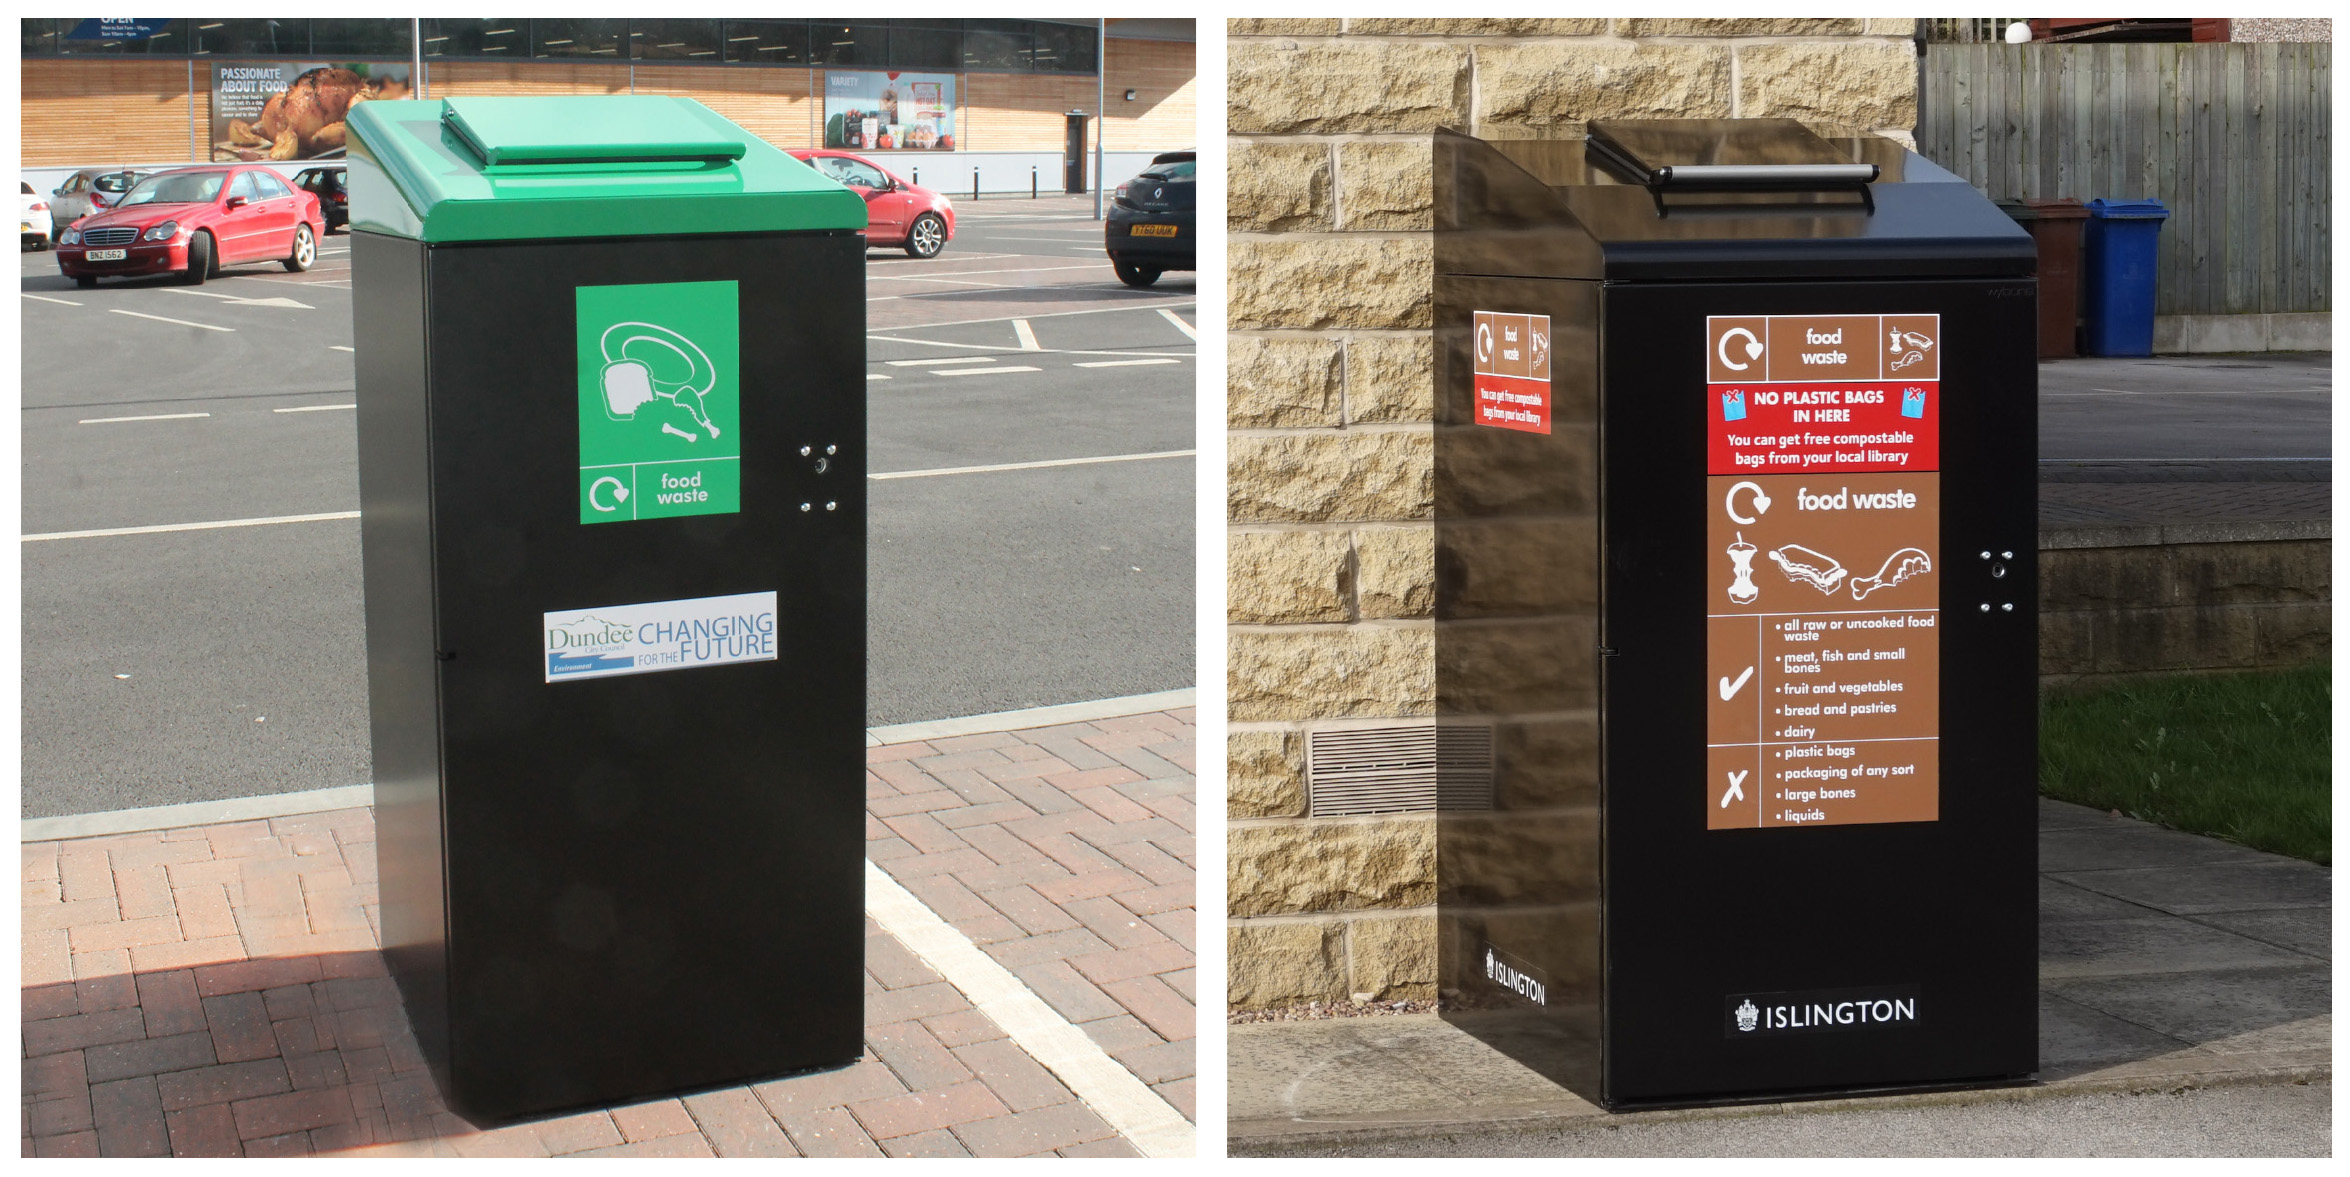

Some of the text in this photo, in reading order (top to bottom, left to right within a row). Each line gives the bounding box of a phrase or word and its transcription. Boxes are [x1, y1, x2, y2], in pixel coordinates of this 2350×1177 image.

[221, 68, 280, 79] PASSIONATE
[831, 76, 859, 86] VARIETY
[221, 81, 256, 92] ABOUT
[1505, 326, 1517, 342] food
[1806, 328, 1842, 345] food
[1503, 348, 1519, 361] waste
[1802, 350, 1847, 365] waste
[1481, 388, 1489, 399] You
[1505, 390, 1514, 402] free
[1515, 392, 1542, 406] compostable
[1754, 390, 1884, 405] NO PLASTIC BAGS
[1483, 405, 1541, 426] bags from your local library
[1793, 409, 1850, 423] IN HERE
[1728, 431, 1914, 448] You can get free compostable
[1735, 450, 1908, 467] bags from your local library
[661, 471, 701, 489] food
[657, 488, 708, 504] waste
[1798, 487, 1916, 511] food waste
[638, 613, 773, 645] CHANGING
[1784, 615, 1935, 631] all raw or uncooked food
[548, 624, 633, 650] Dundee
[1784, 631, 1819, 641] waste
[585, 644, 625, 655] City Council
[639, 632, 774, 666] FOR THE FUTURE
[1784, 648, 1905, 664] meat, fish and small
[554, 663, 592, 672] Environment
[1784, 661, 1821, 674] bones
[1784, 680, 1903, 696] fruit and vegetables
[1784, 701, 1896, 717] bread and pastries
[1784, 725, 1815, 739] dairy
[1785, 744, 1855, 760] plastic bags
[1785, 764, 1914, 782] packaging of any sort
[1785, 787, 1856, 802] large bones
[1785, 808, 1825, 824] liquids
[1495, 960, 1544, 1006] ISLINGTON
[1767, 998, 1914, 1029] ISLINGTON
